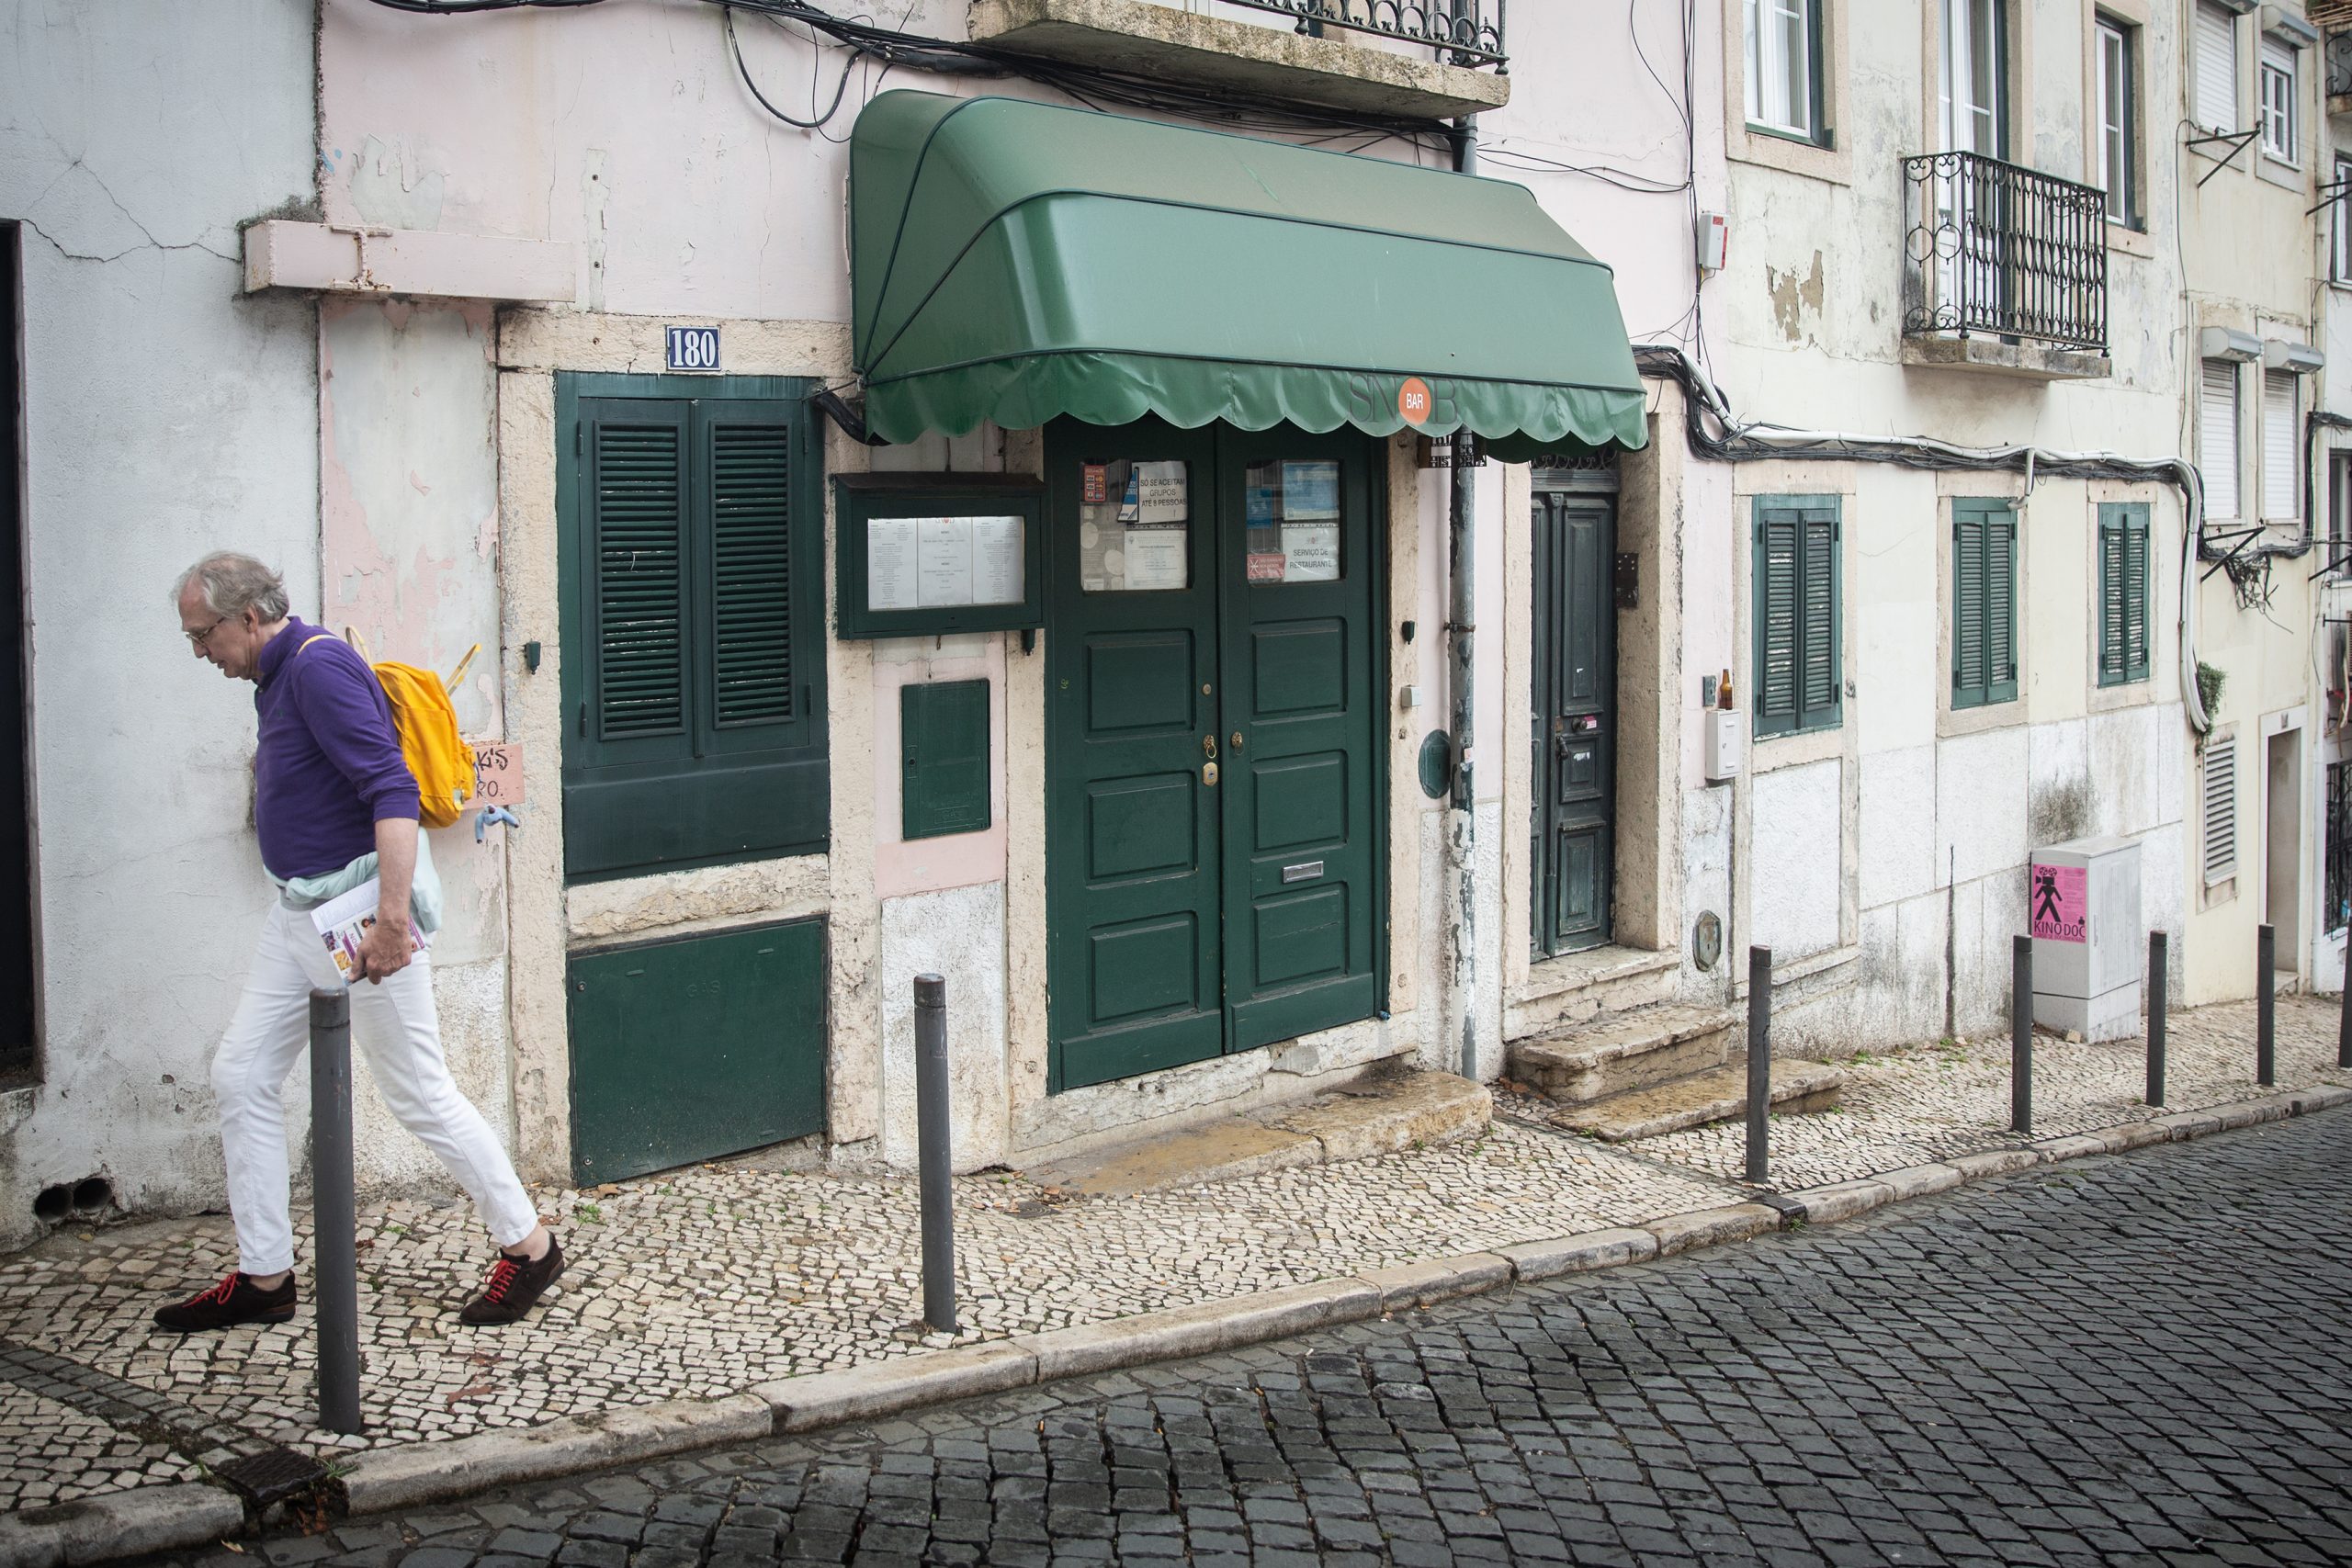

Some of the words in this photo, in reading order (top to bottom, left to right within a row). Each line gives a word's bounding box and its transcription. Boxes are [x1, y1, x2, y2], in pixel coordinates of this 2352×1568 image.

[672, 330, 716, 367] 180
[1406, 392, 1424, 410] BAR
[1294, 547, 1319, 557] SERVIÇO
[1290, 560, 1333, 569] RESTAURANTE
